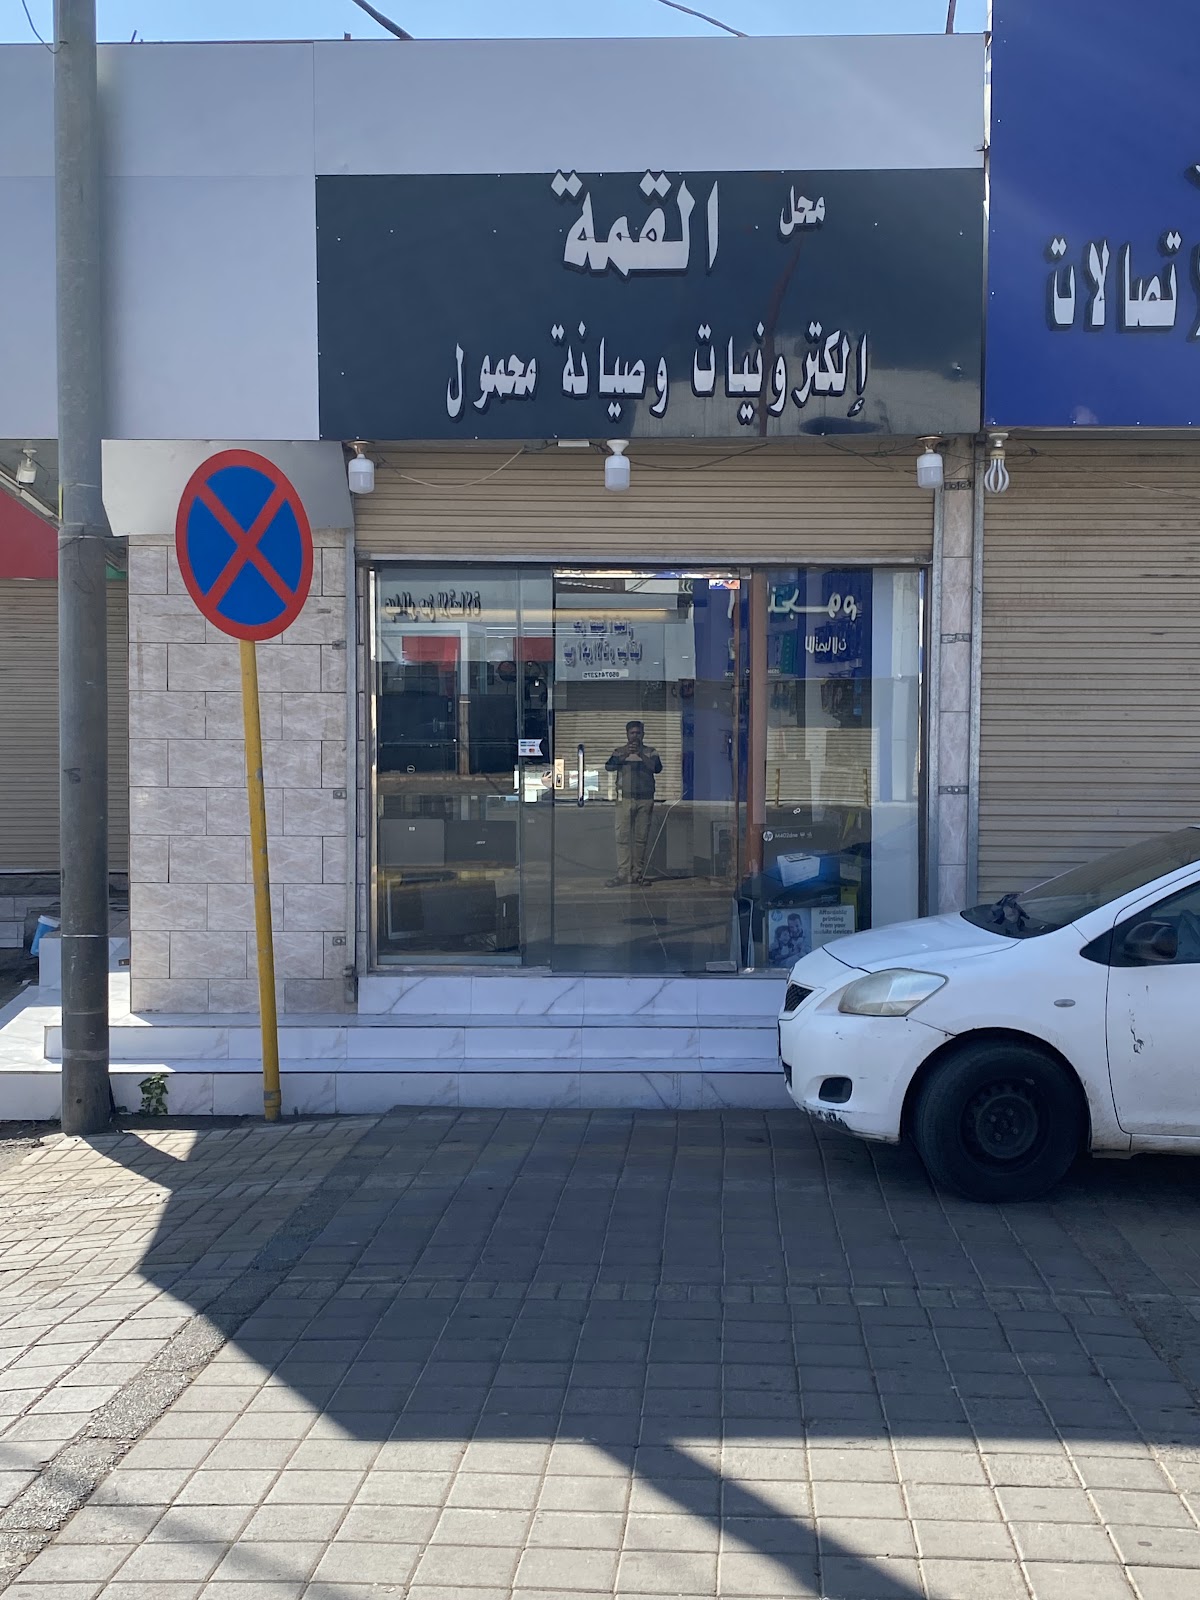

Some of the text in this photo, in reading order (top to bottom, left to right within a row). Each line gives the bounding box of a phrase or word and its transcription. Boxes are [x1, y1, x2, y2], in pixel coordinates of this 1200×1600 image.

[550, 170, 826, 276] محل القمة
[446, 320, 869, 421] إلكترونيات وصيانة محمول
